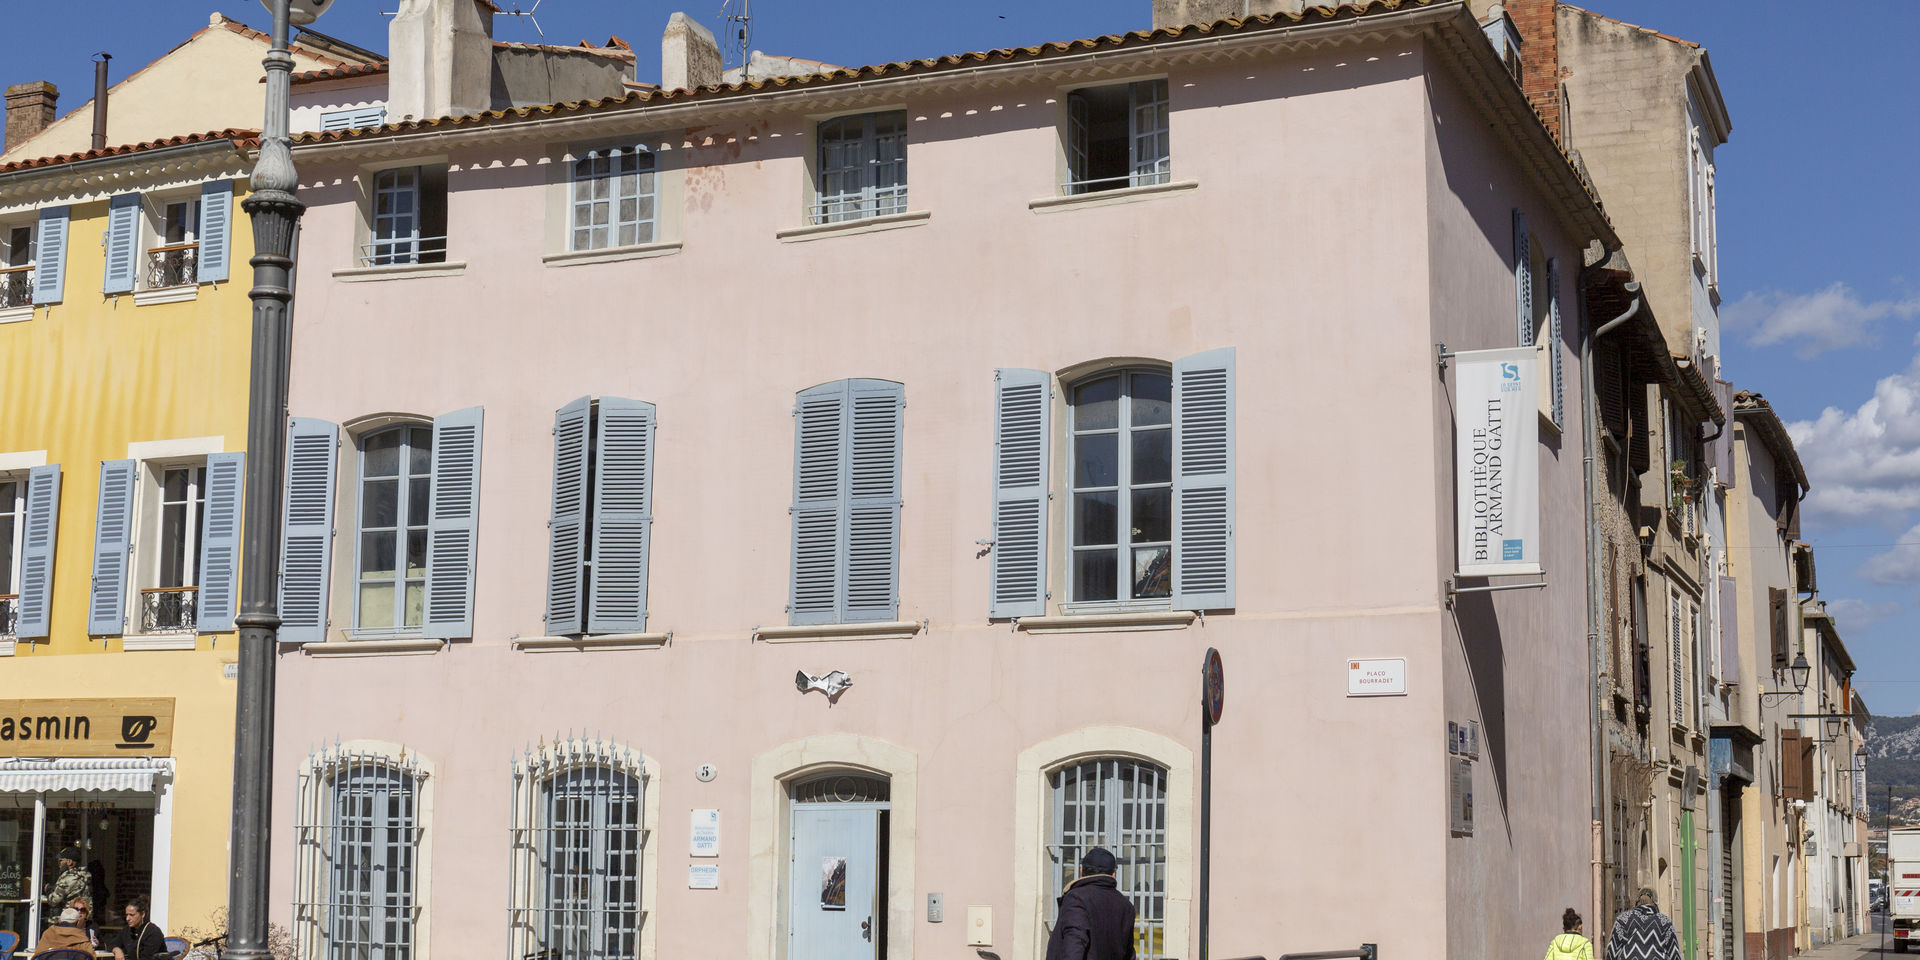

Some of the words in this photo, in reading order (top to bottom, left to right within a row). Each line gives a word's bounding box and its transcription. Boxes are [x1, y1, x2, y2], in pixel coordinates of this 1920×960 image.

[1488, 398, 1502, 450] GATTI
[1470, 428, 1488, 561] BIBLIOTHÈQUE
[1489, 455, 1503, 537] ARMAND
[0, 716, 90, 741] asmin
[701, 766, 709, 777] 5
